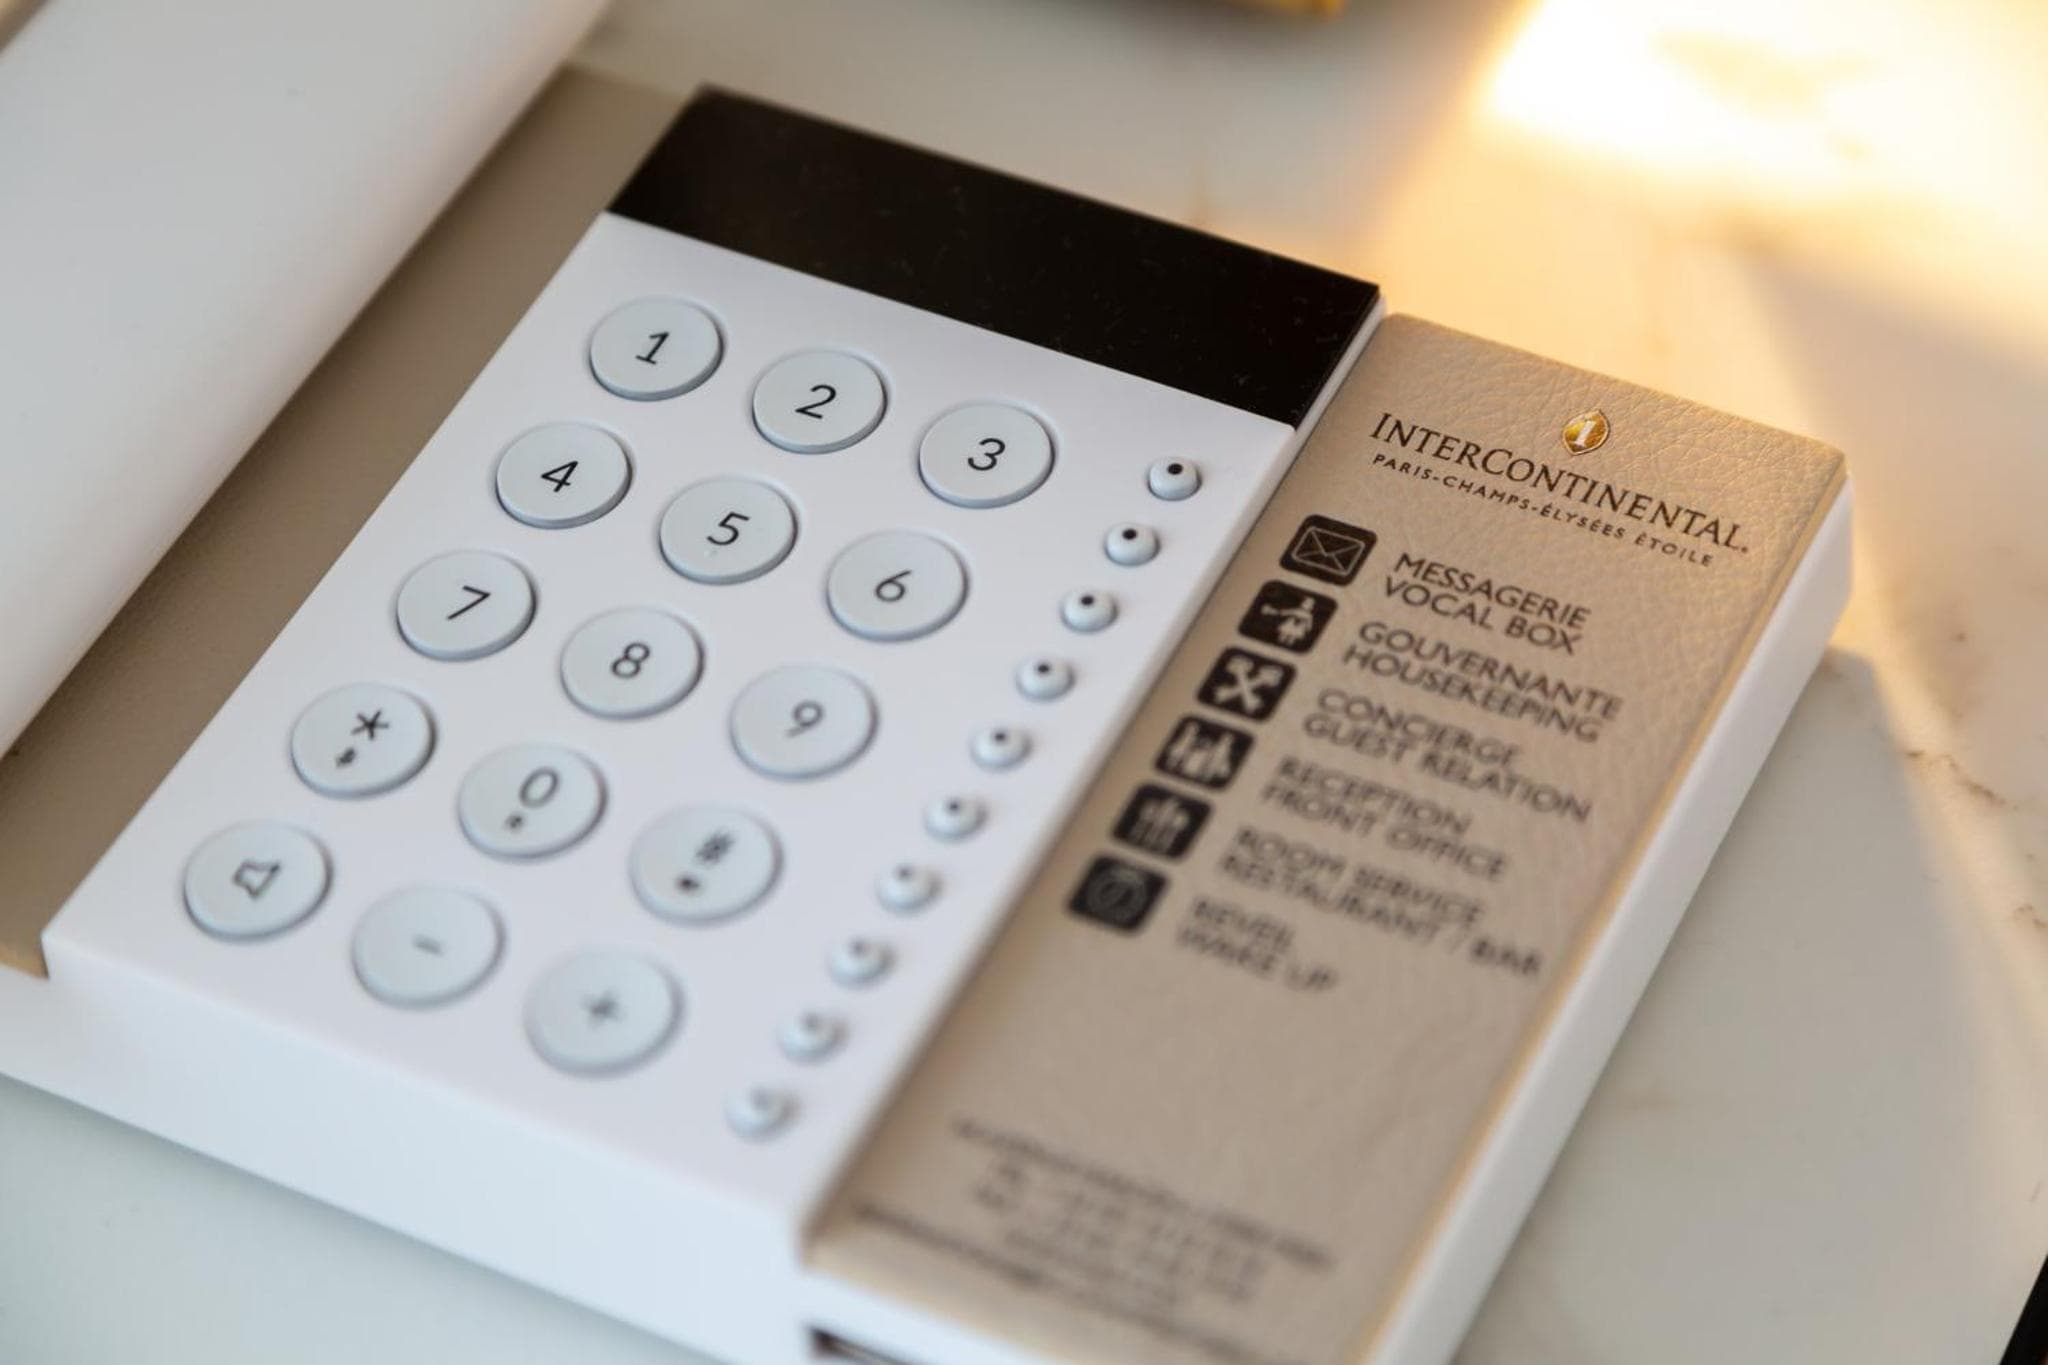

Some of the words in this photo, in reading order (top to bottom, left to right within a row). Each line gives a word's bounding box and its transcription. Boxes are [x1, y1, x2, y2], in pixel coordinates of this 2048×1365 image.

[635, 331, 671, 365] 1
[795, 384, 837, 420] 2
[966, 437, 1006, 471] 3
[540, 459, 579, 493] 4
[706, 511, 750, 546] 5
[1635, 532, 1713, 567] ÉTOILE
[446, 584, 491, 620] 7
[874, 569, 911, 602] 6
[1394, 552, 1591, 630] MESSAGERIE
[1385, 576, 1495, 629] VOCAL
[1505, 616, 1583, 656] BOX
[610, 642, 650, 679] 8
[1358, 621, 1624, 722] GOUVERNANTE
[1342, 644, 1600, 743] HOUSEKEEPING
[786, 699, 826, 738] 9
[1317, 688, 1521, 766] CONCIERGE
[1303, 713, 1411, 764] GUEST
[1421, 750, 1592, 823] RELATION
[518, 767, 561, 811] 0
